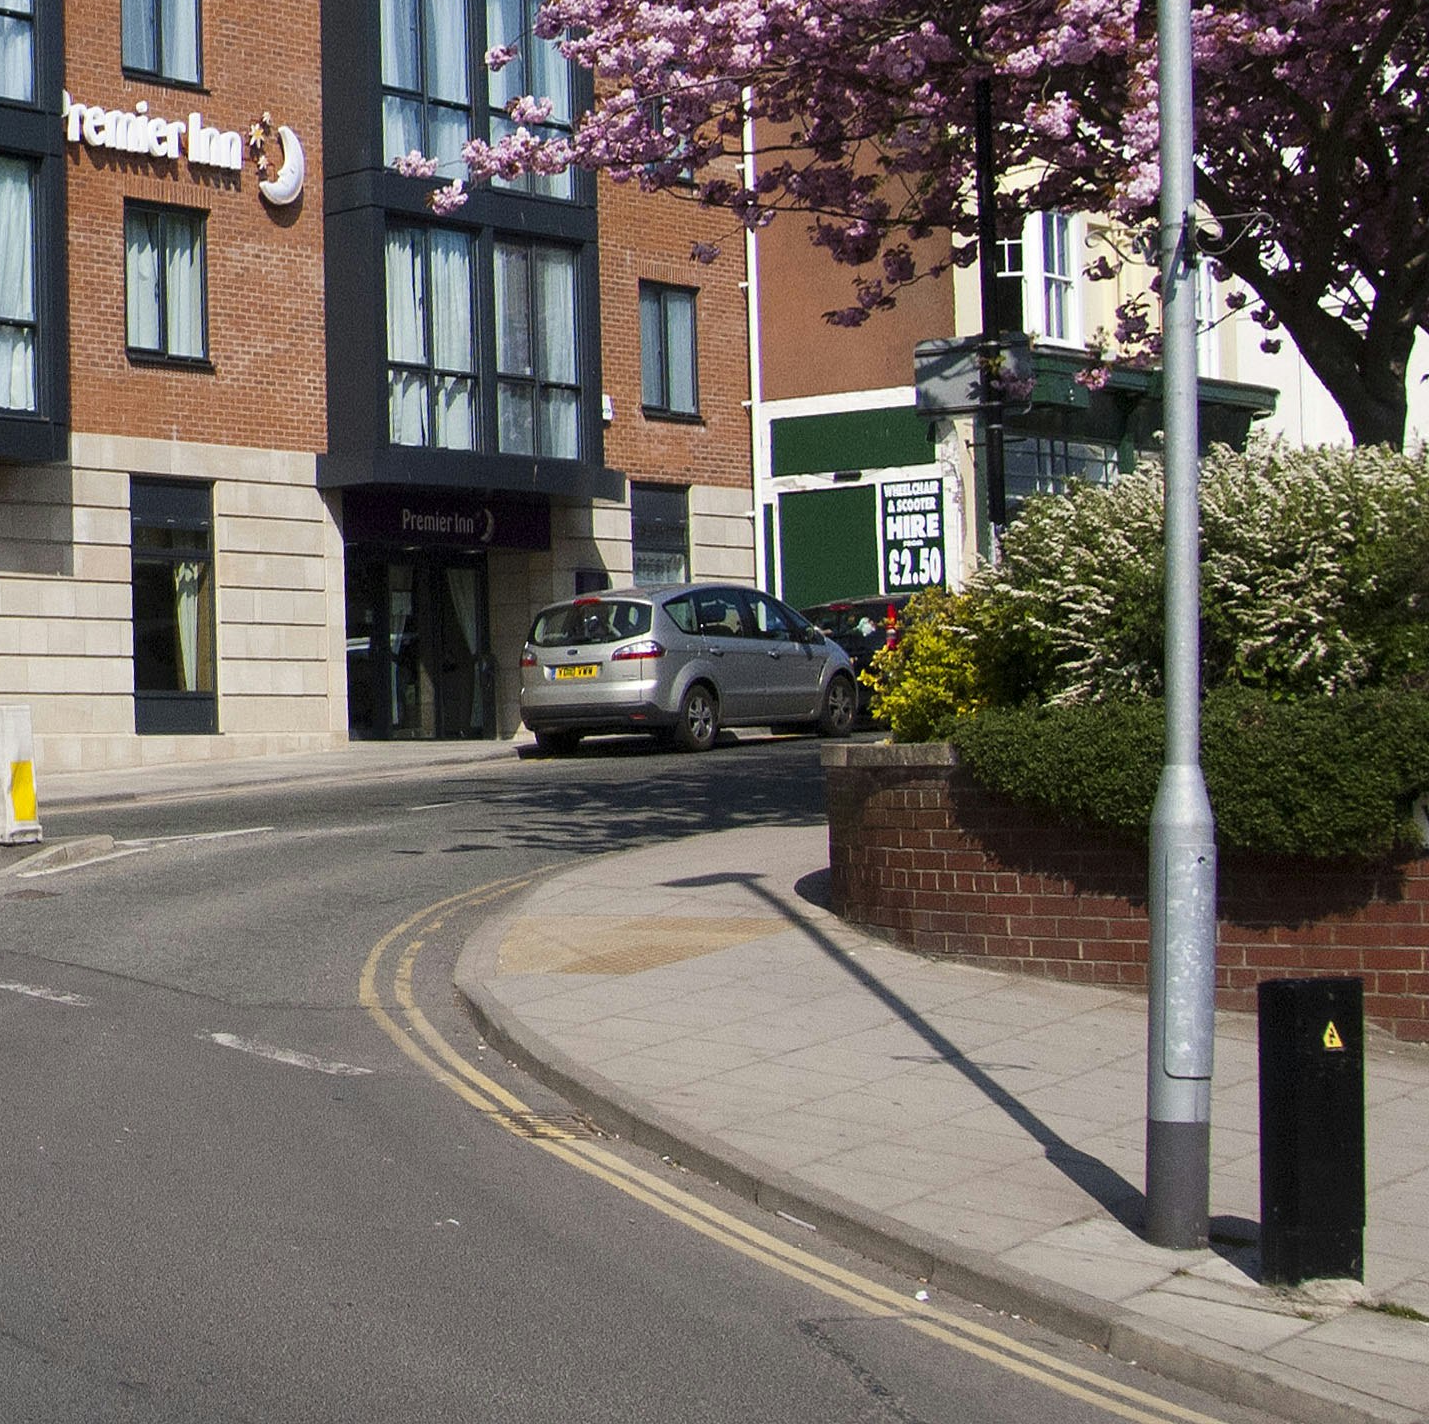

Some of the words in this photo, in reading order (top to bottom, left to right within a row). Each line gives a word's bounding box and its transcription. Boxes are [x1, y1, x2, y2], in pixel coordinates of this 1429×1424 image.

[188, 112, 242, 170] Inn
[884, 480, 939, 497] WHEELCHAIR
[887, 499, 895, 513] &
[896, 496, 936, 512] SCOOTER
[403, 508, 453, 533] Premier
[455, 513, 474, 534] Inn
[886, 513, 939, 540] HIRE
[889, 547, 941, 585] £2.50
